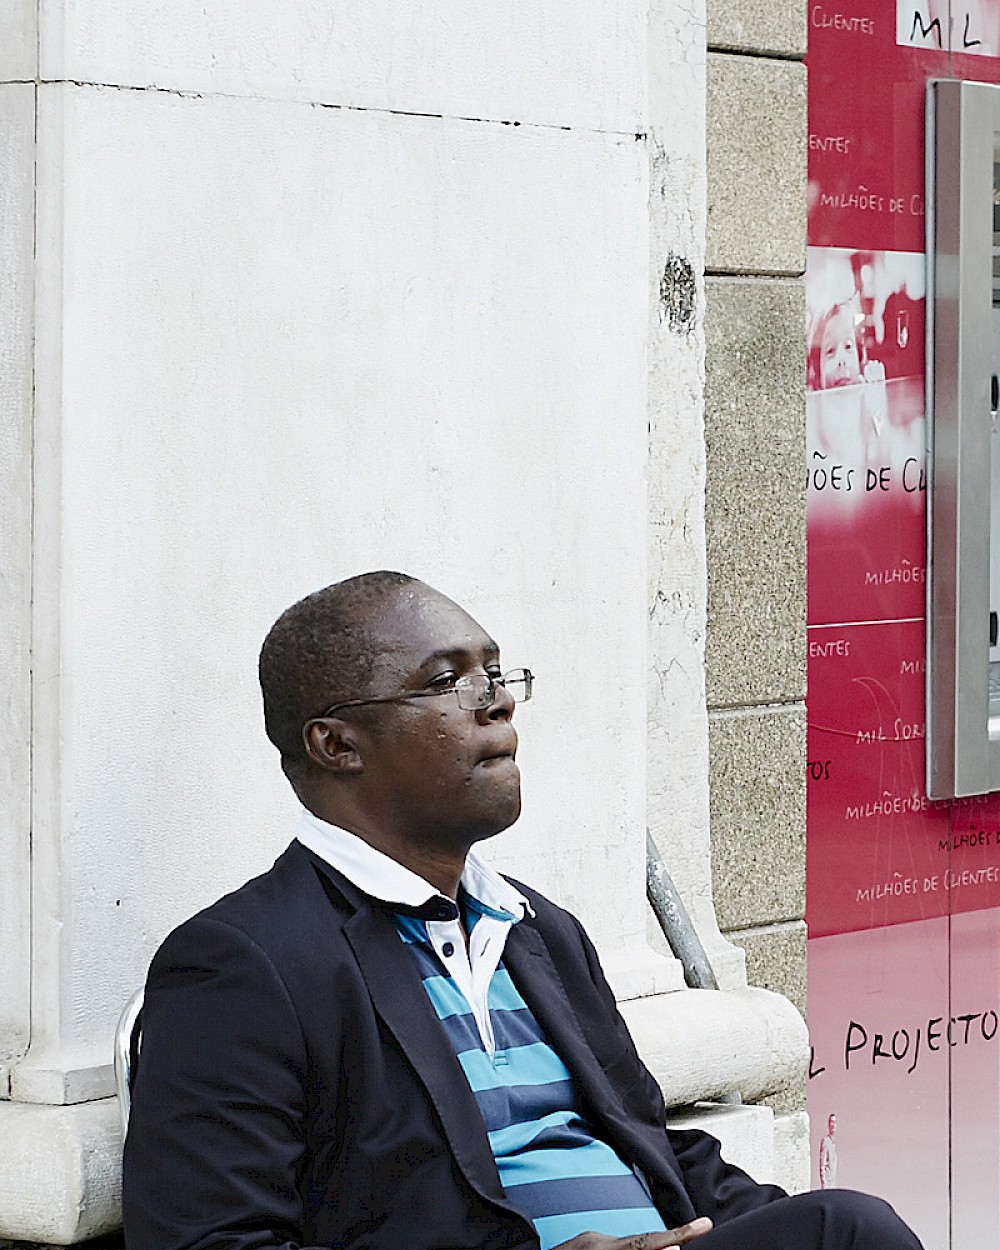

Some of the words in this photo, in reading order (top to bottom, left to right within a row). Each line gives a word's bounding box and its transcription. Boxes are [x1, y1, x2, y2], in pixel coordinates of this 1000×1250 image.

[812, 5, 875, 35] CLIENTES
[910, 11, 981, 49] MIL
[809, 134, 851, 154] ENTES
[820, 185, 885, 212] MILHÕES
[889, 198, 905, 214] DE
[866, 467, 891, 492] DE
[809, 640, 851, 657] ENTES
[856, 727, 887, 745] MIL
[845, 790, 907, 820] MILHÕES
[856, 871, 918, 902] MILHÕES
[923, 875, 938, 892] DE
[943, 866, 1000, 891] CLIENTES
